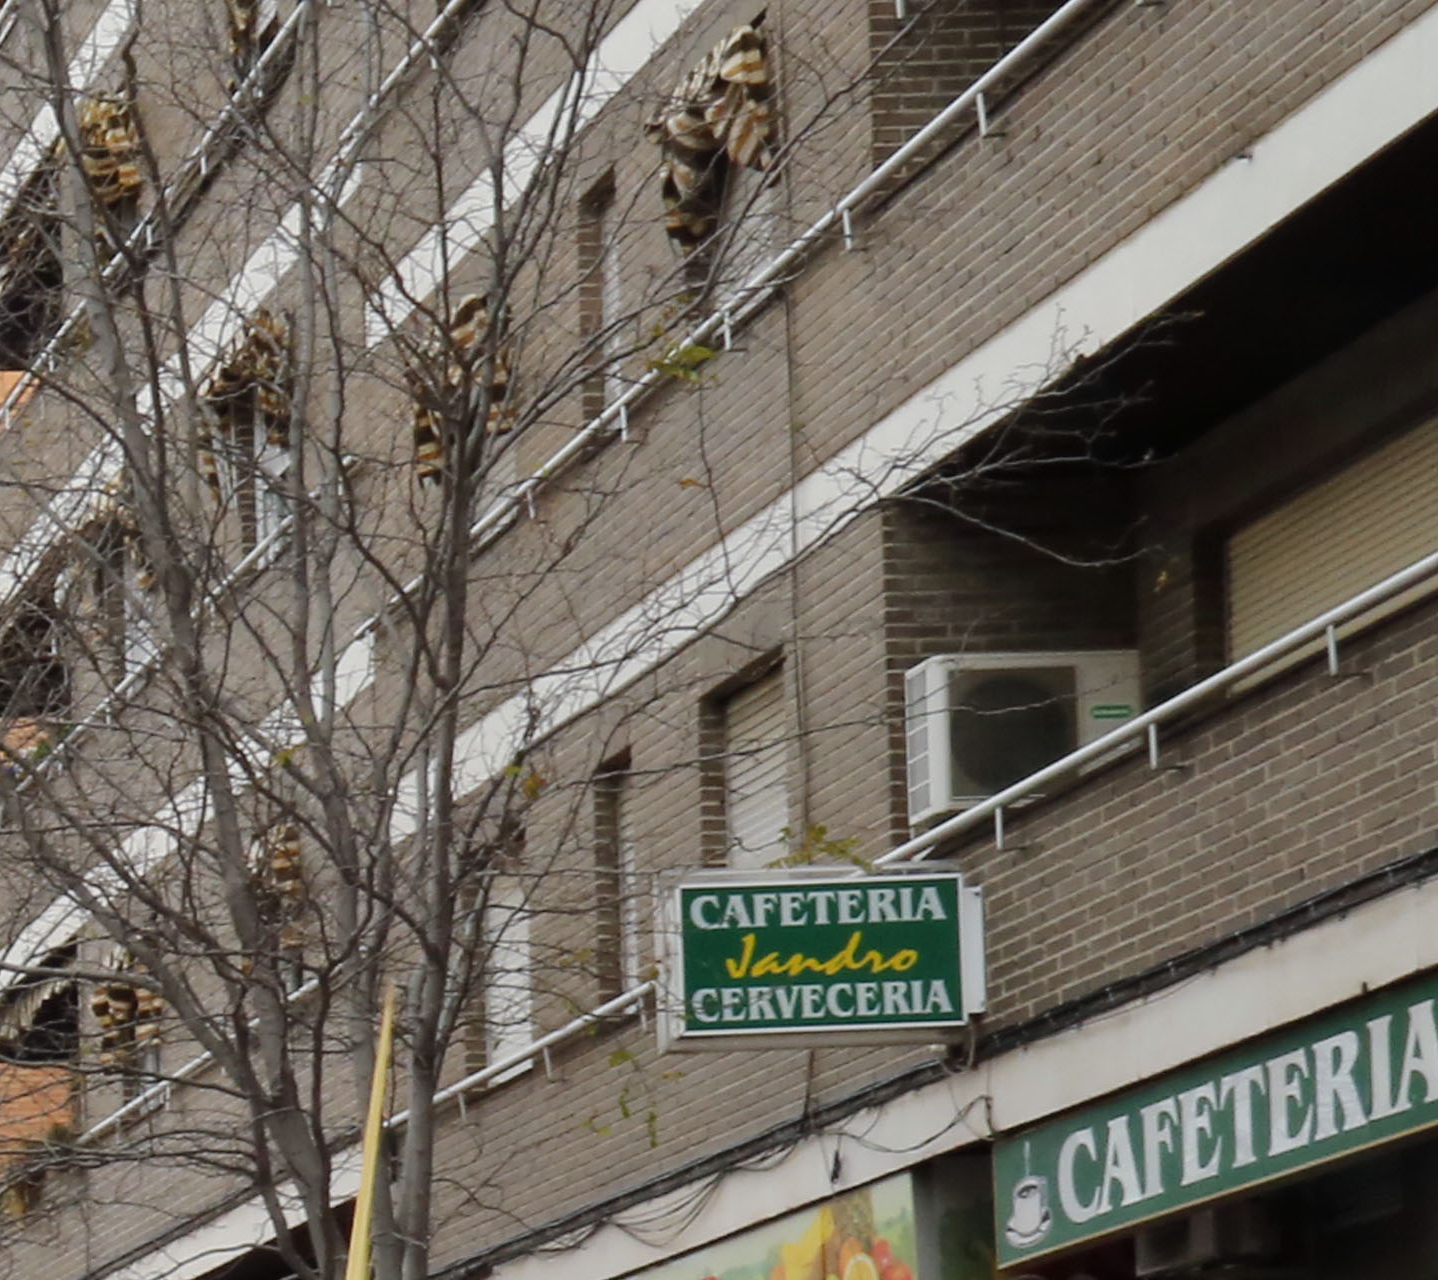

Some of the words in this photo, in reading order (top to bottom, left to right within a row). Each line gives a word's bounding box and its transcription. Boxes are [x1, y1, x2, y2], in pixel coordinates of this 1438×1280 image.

[689, 887, 947, 930] CAFETERIA
[725, 932, 918, 979] Jandro
[691, 979, 954, 1023] CERVECERIA
[1057, 999, 1438, 1224] CAFETERIA
